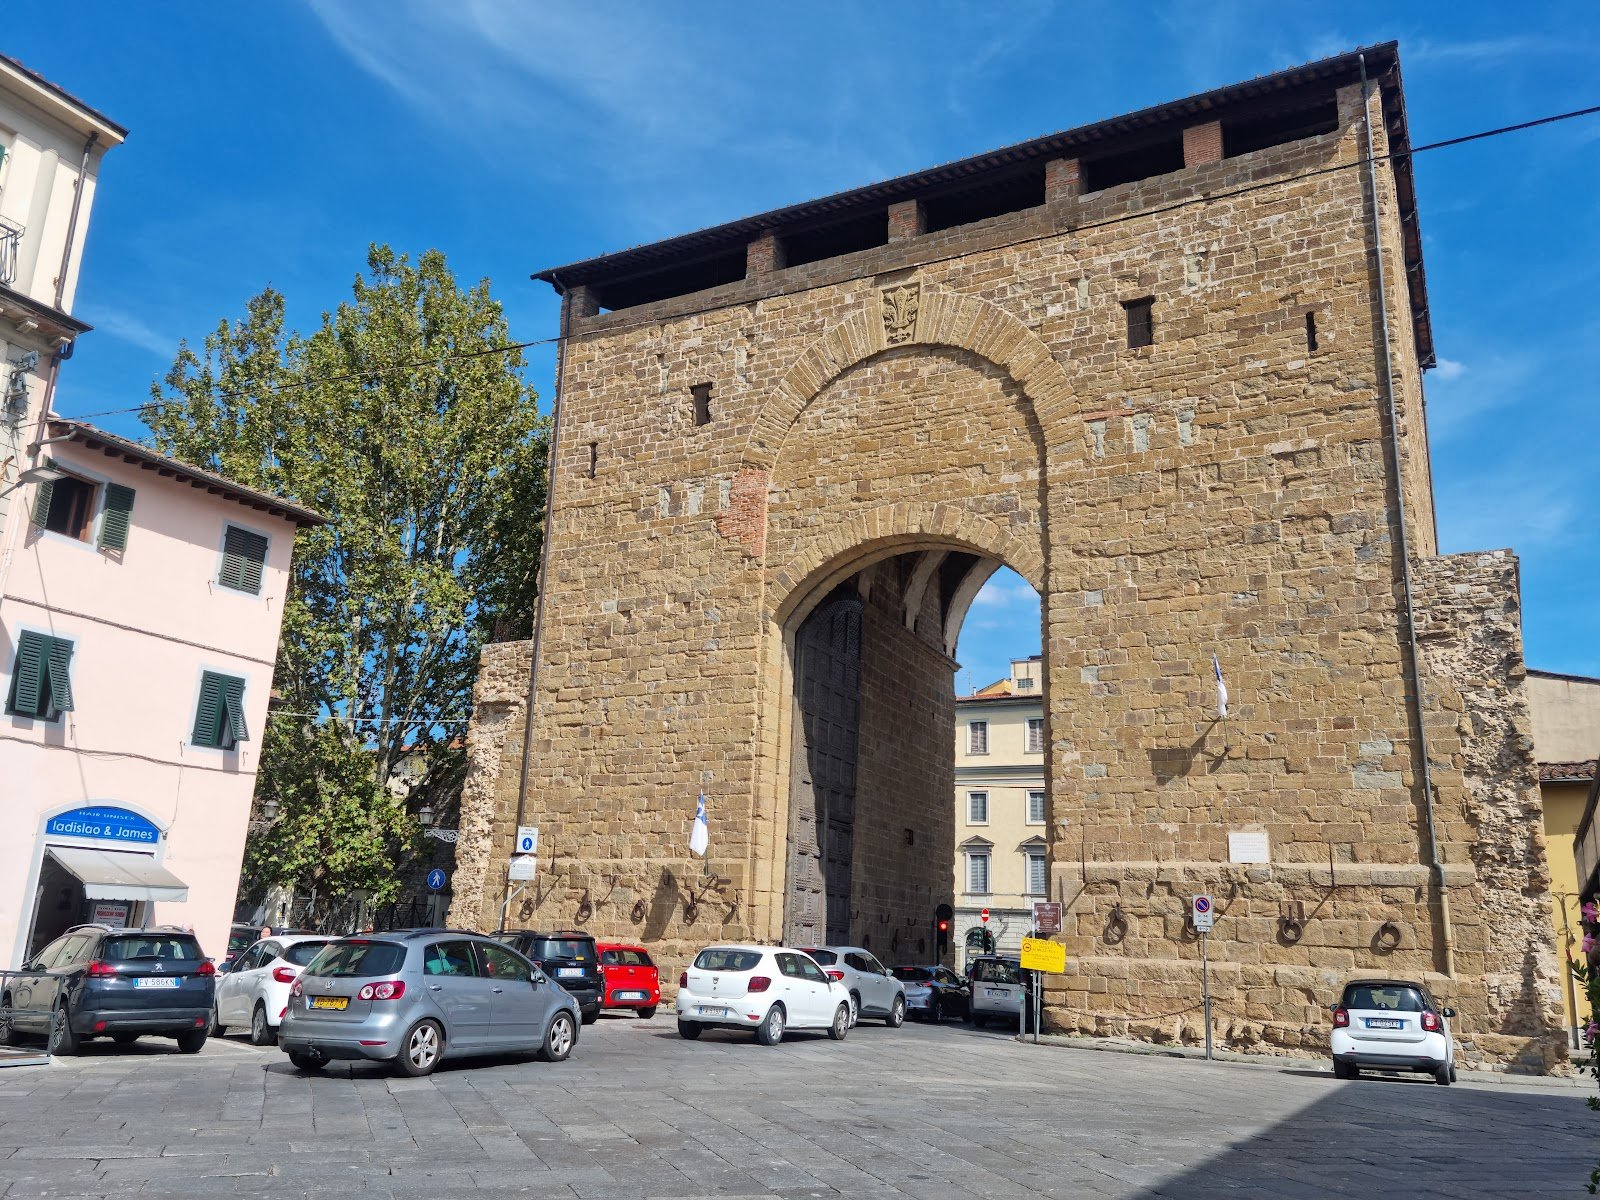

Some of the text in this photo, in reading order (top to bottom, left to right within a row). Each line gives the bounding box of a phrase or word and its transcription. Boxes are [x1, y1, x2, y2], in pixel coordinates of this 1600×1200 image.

[103, 813, 136, 821] UNISEX
[52, 820, 153, 840] ladislao & James
